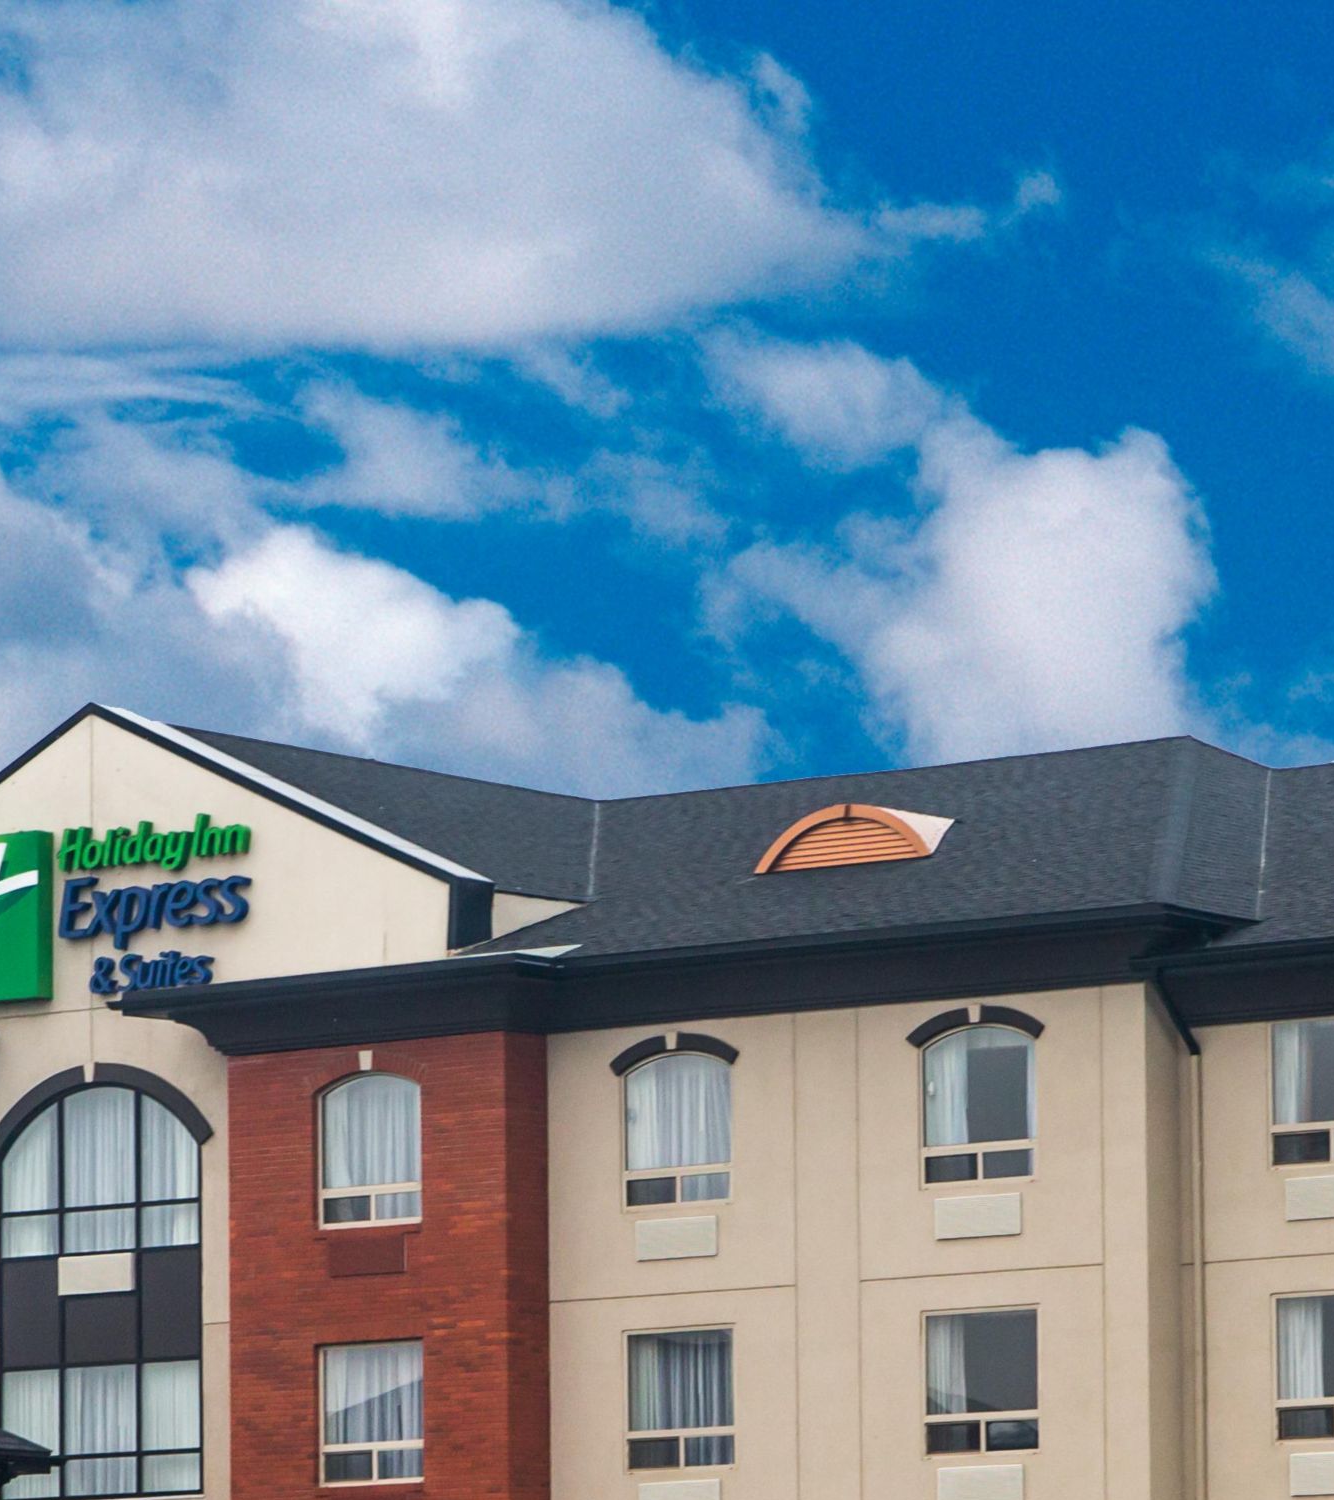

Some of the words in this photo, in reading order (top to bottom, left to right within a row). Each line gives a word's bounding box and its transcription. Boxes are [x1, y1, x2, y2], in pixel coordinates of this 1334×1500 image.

[58, 821, 193, 871] Holiday
[192, 813, 252, 857] Inn
[59, 875, 252, 950] Express
[90, 956, 118, 994] &
[118, 950, 215, 991] Suites
